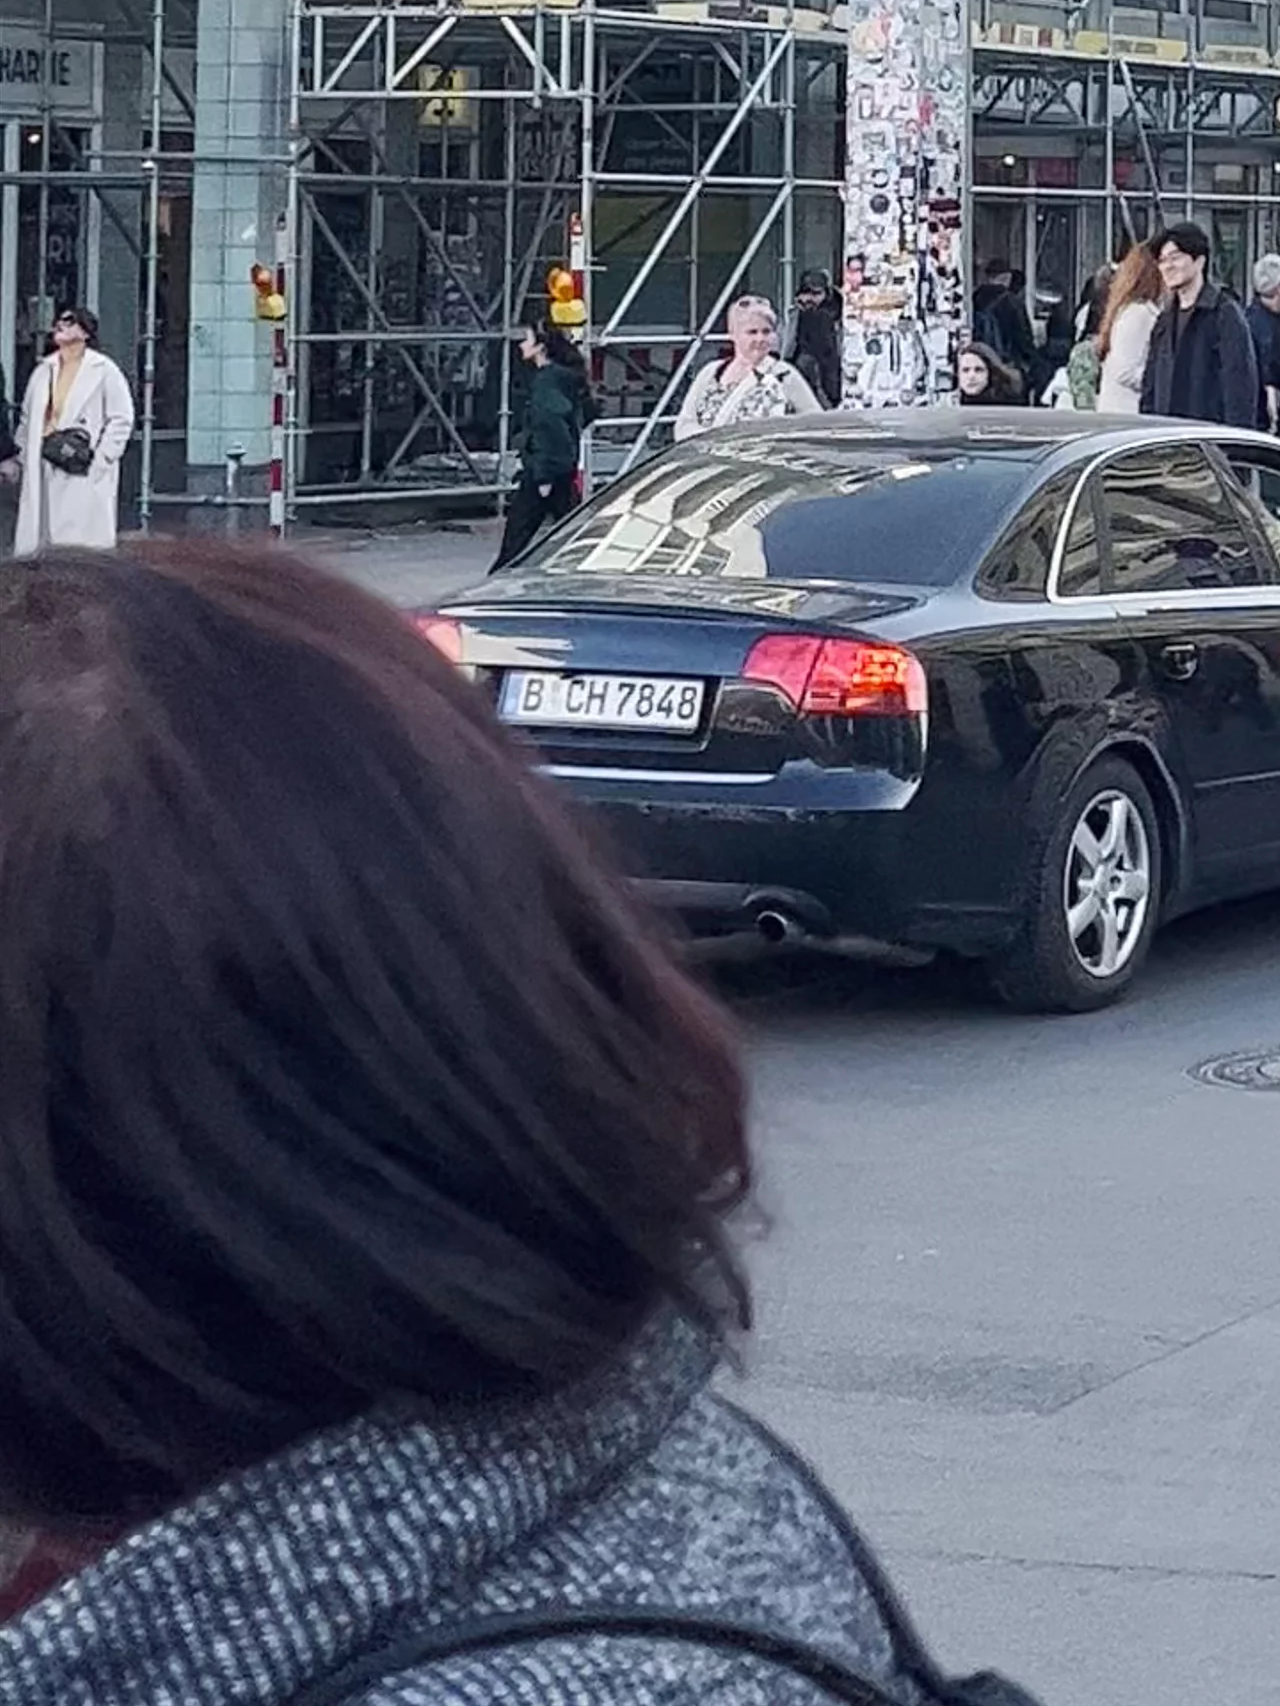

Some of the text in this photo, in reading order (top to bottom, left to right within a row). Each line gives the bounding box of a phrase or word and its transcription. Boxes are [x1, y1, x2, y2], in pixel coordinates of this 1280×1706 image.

[522, 677, 698, 721] B CH 7848
